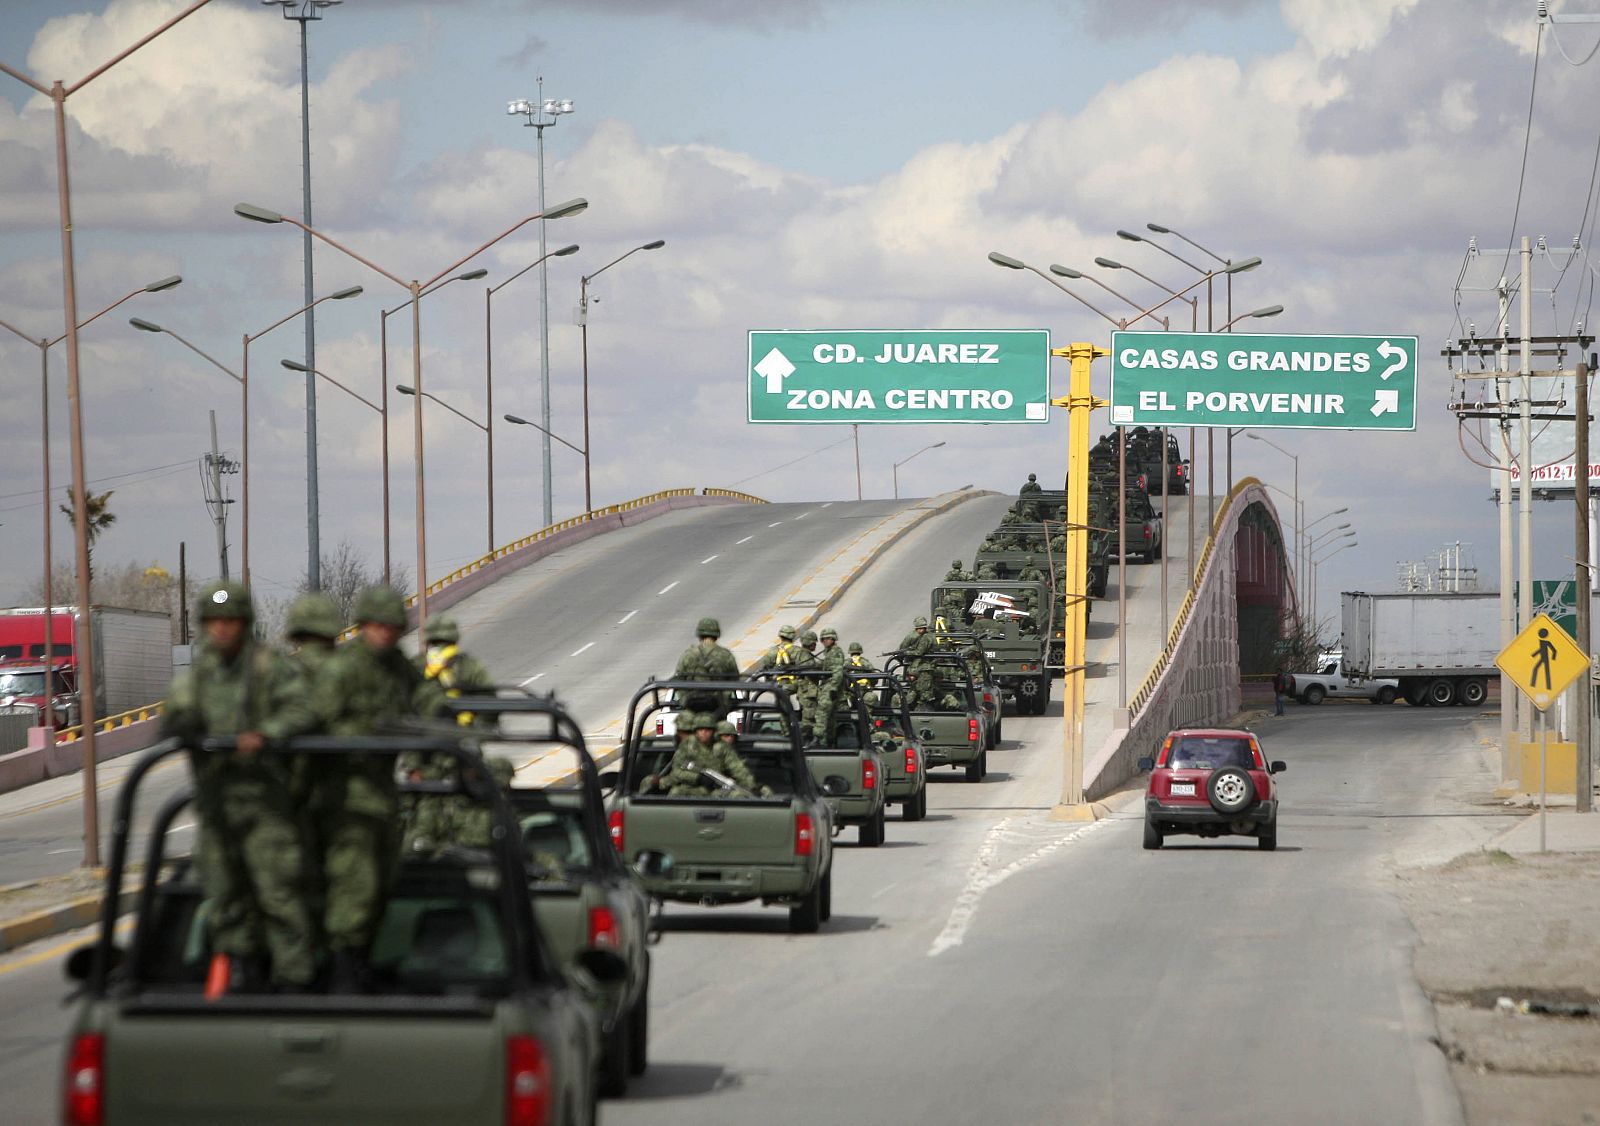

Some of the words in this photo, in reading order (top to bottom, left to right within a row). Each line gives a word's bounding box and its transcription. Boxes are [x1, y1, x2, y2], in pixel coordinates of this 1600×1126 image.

[813, 344, 864, 363] CD.
[875, 344, 999, 363] JUAREZ
[1119, 349, 1218, 369] CASAS
[1228, 351, 1370, 372] GRANDES
[787, 390, 875, 409] ZONA
[885, 390, 1013, 409] CENTRO
[1139, 391, 1176, 410] EL
[1187, 391, 1345, 414] PORVENIR
